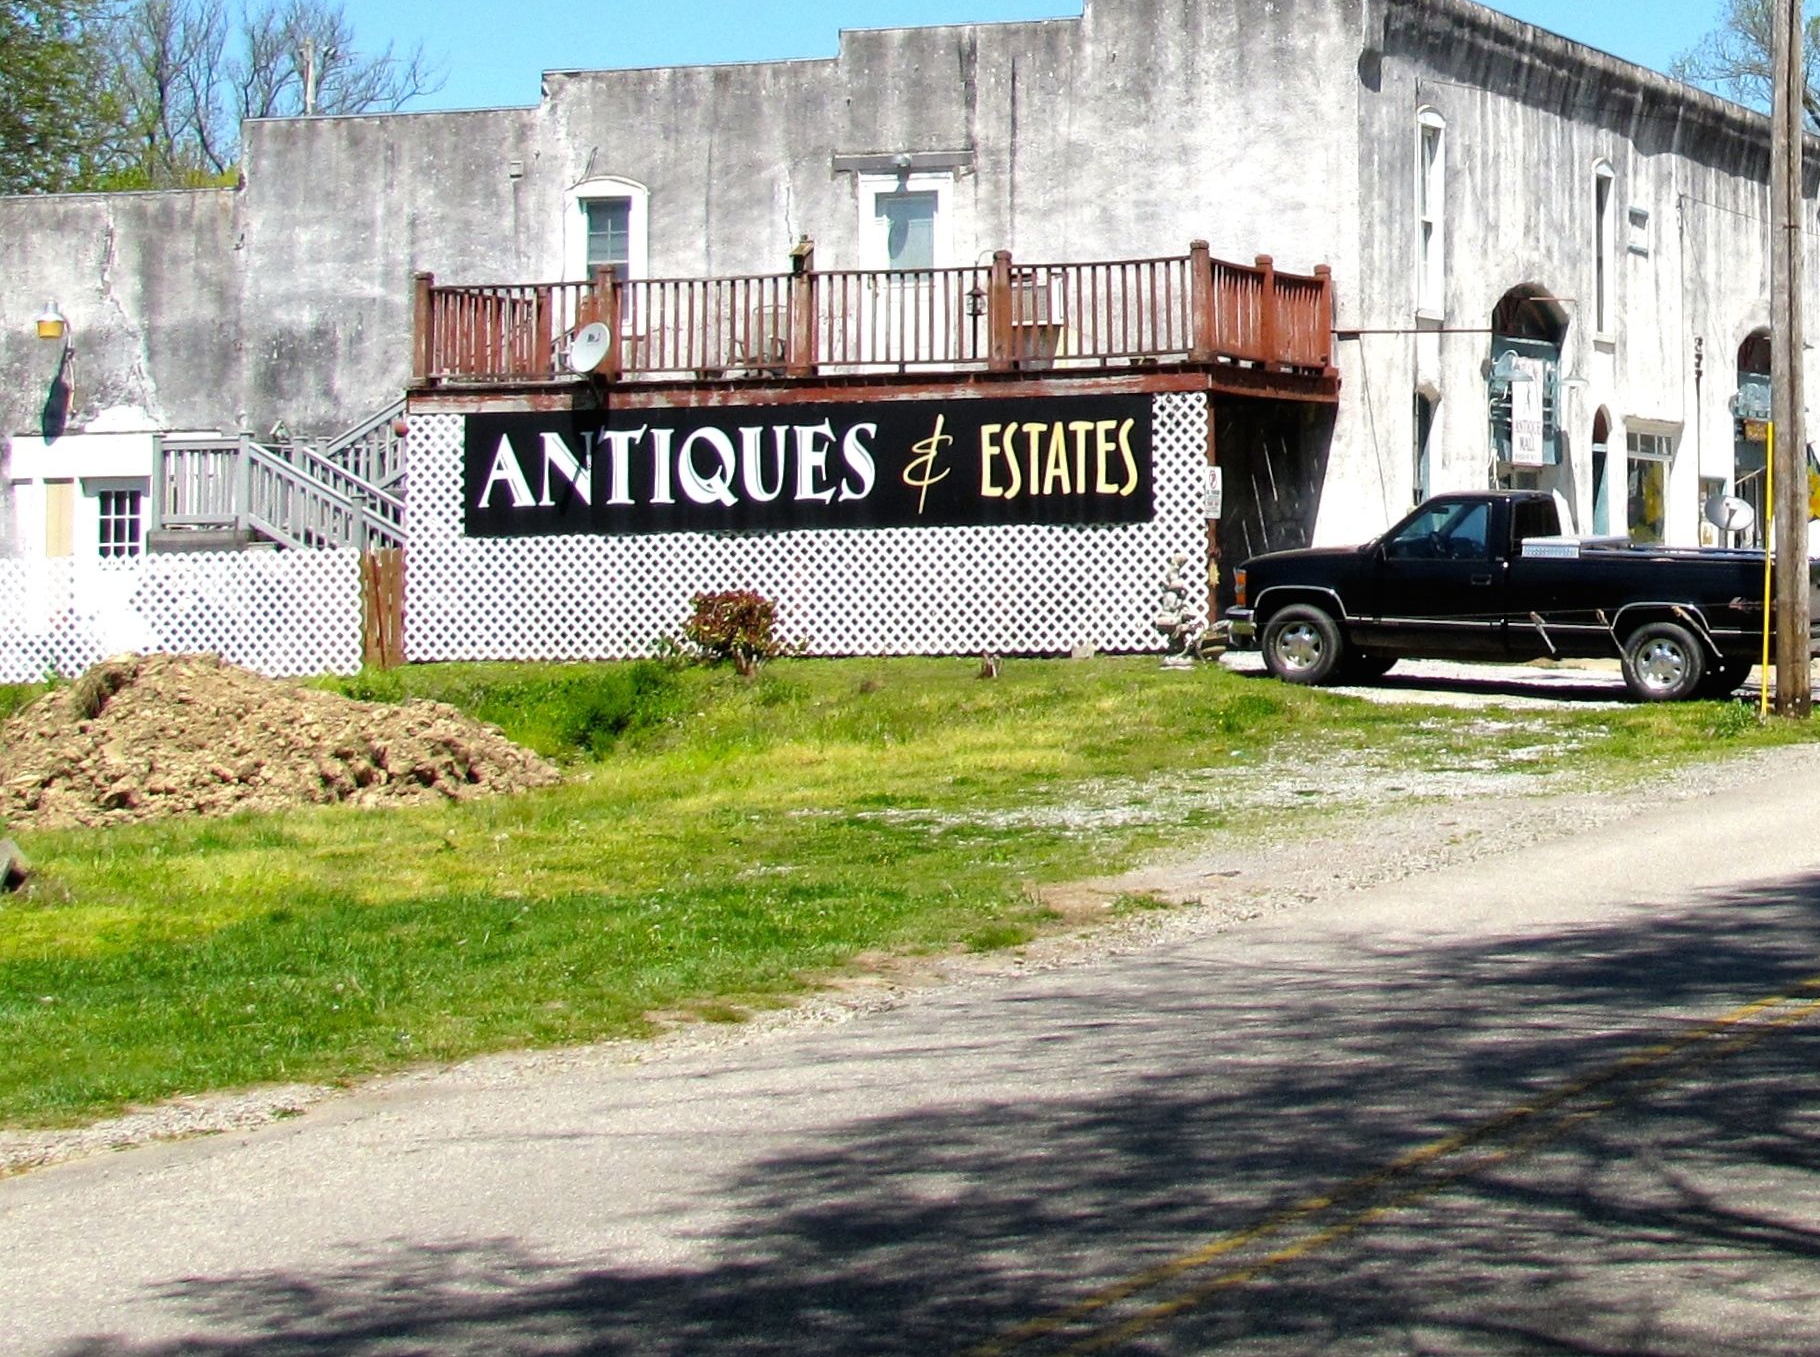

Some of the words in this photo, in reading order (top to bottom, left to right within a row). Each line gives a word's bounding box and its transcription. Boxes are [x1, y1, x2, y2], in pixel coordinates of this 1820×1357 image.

[477, 417, 879, 510] ANTIQUES
[902, 413, 955, 514] &
[979, 417, 1139, 501] ESTATES
